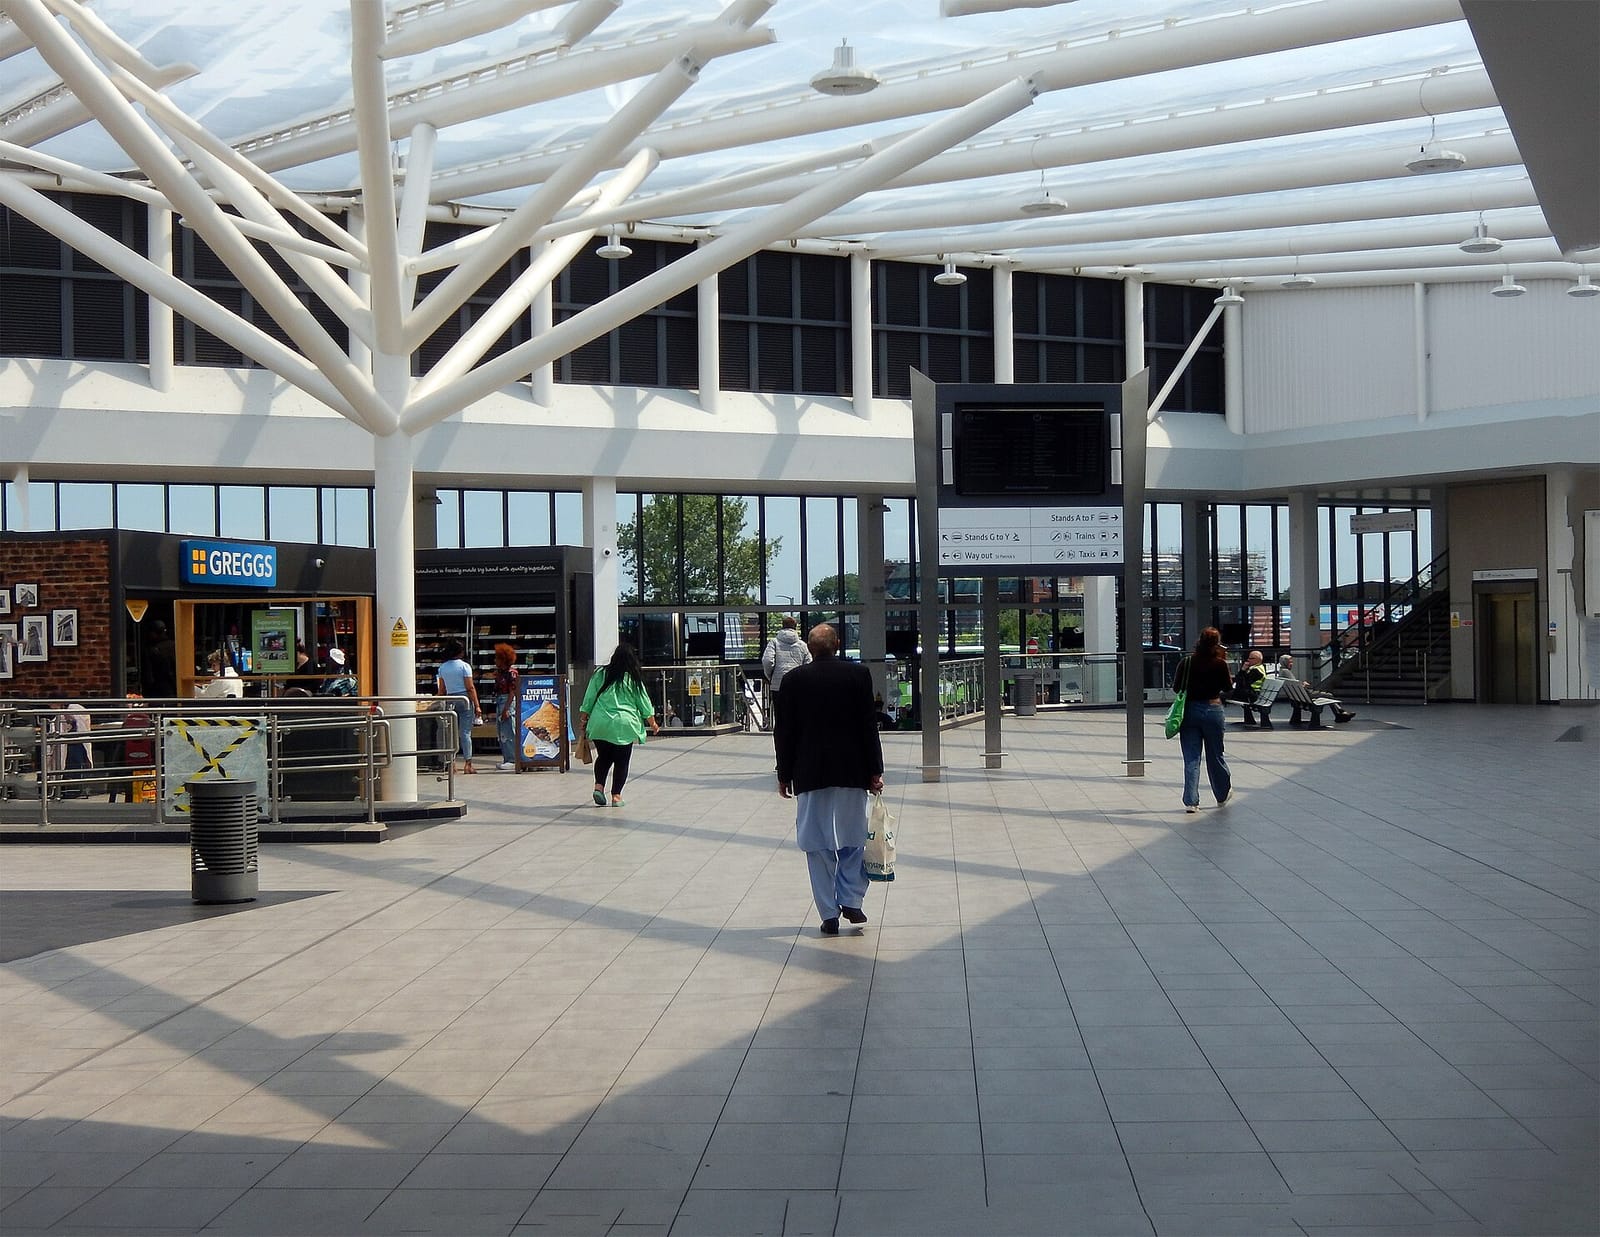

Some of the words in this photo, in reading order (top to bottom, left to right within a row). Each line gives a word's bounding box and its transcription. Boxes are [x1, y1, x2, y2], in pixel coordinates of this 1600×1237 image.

[1051, 514, 1074, 522] Stands
[1076, 514, 1081, 522] A
[964, 533, 988, 541] Stands
[1075, 532, 1096, 540] Trains
[965, 552, 980, 561] Way
[1079, 550, 1096, 558] Taxis
[209, 550, 273, 578] GREGGS
